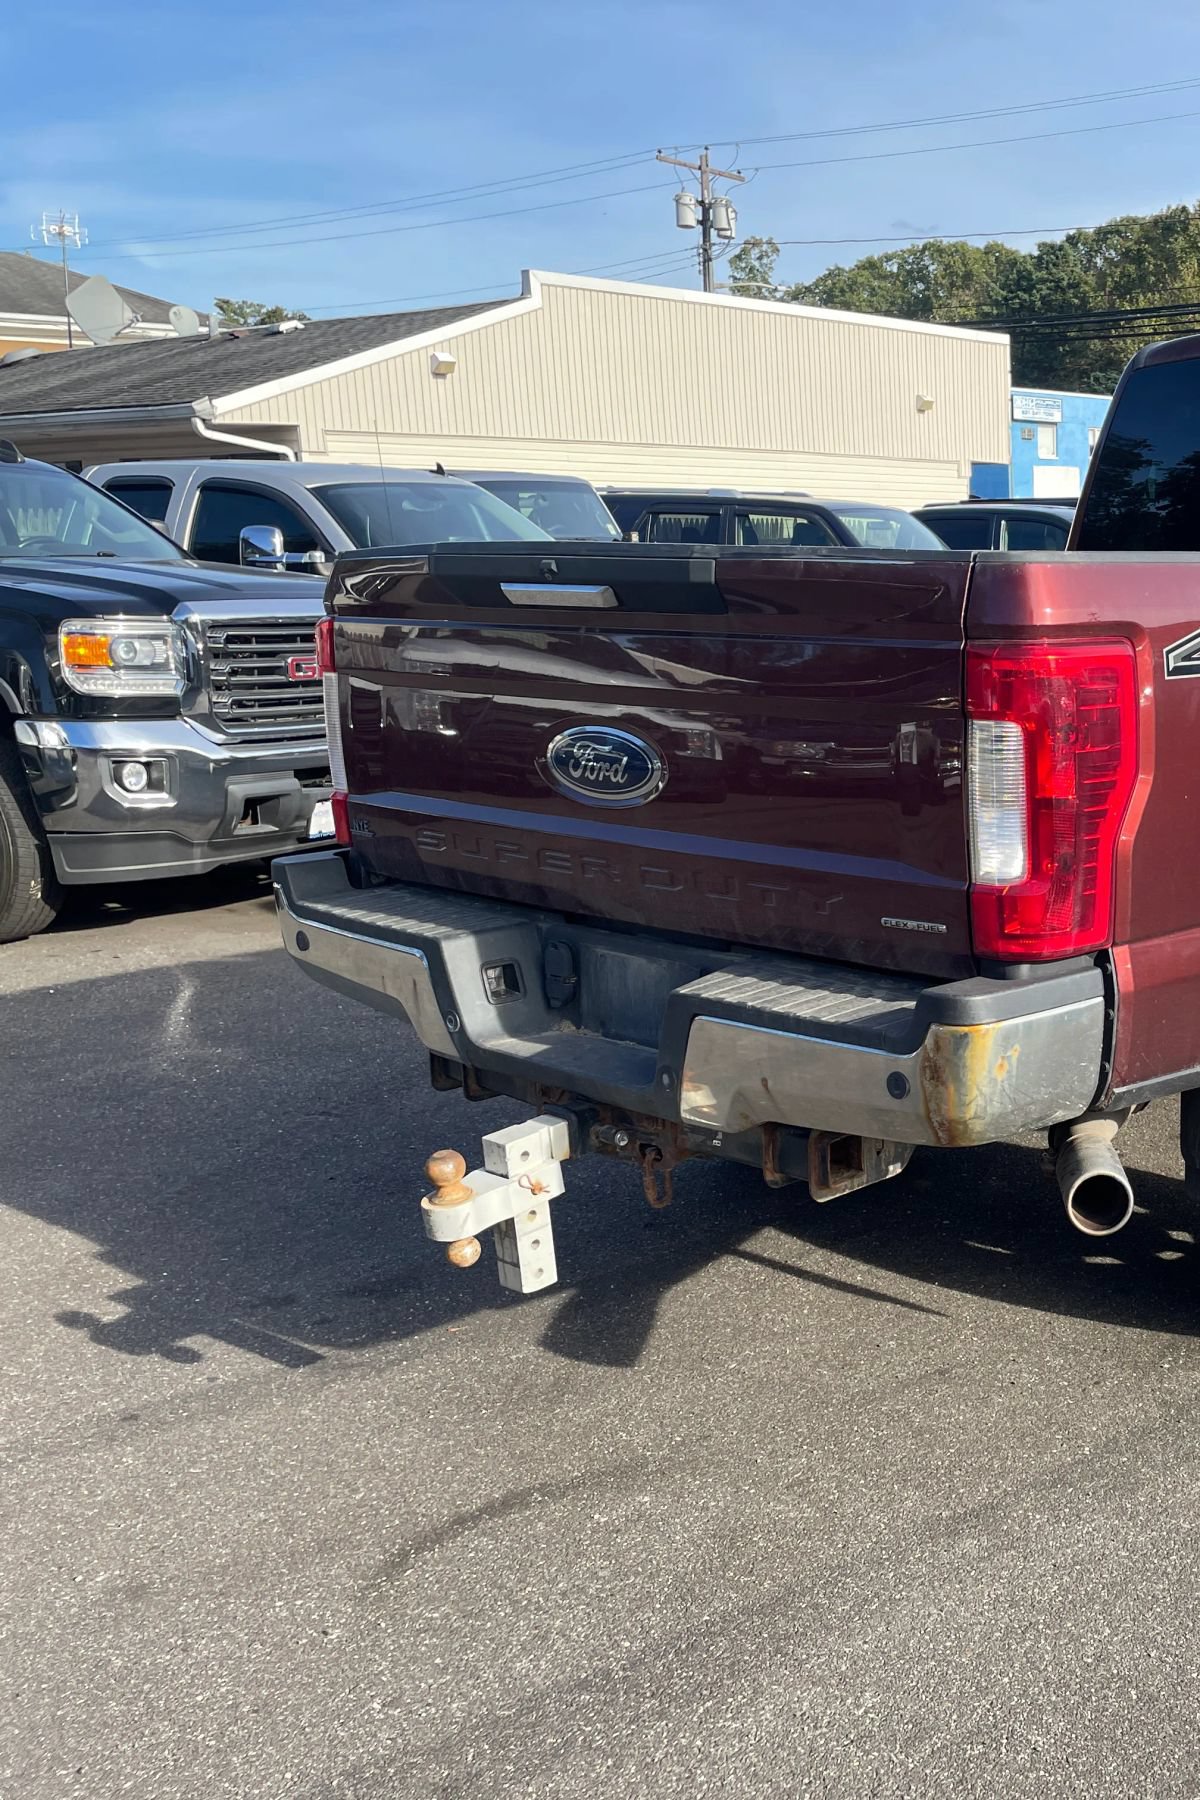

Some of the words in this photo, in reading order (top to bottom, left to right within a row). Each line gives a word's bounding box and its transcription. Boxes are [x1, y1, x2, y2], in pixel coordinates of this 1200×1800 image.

[568, 740, 628, 783] Ford
[416, 828, 621, 883] SUPER
[640, 866, 844, 915] DUTY
[883, 919, 908, 929] FLEX
[917, 923, 944, 933] FUEL
